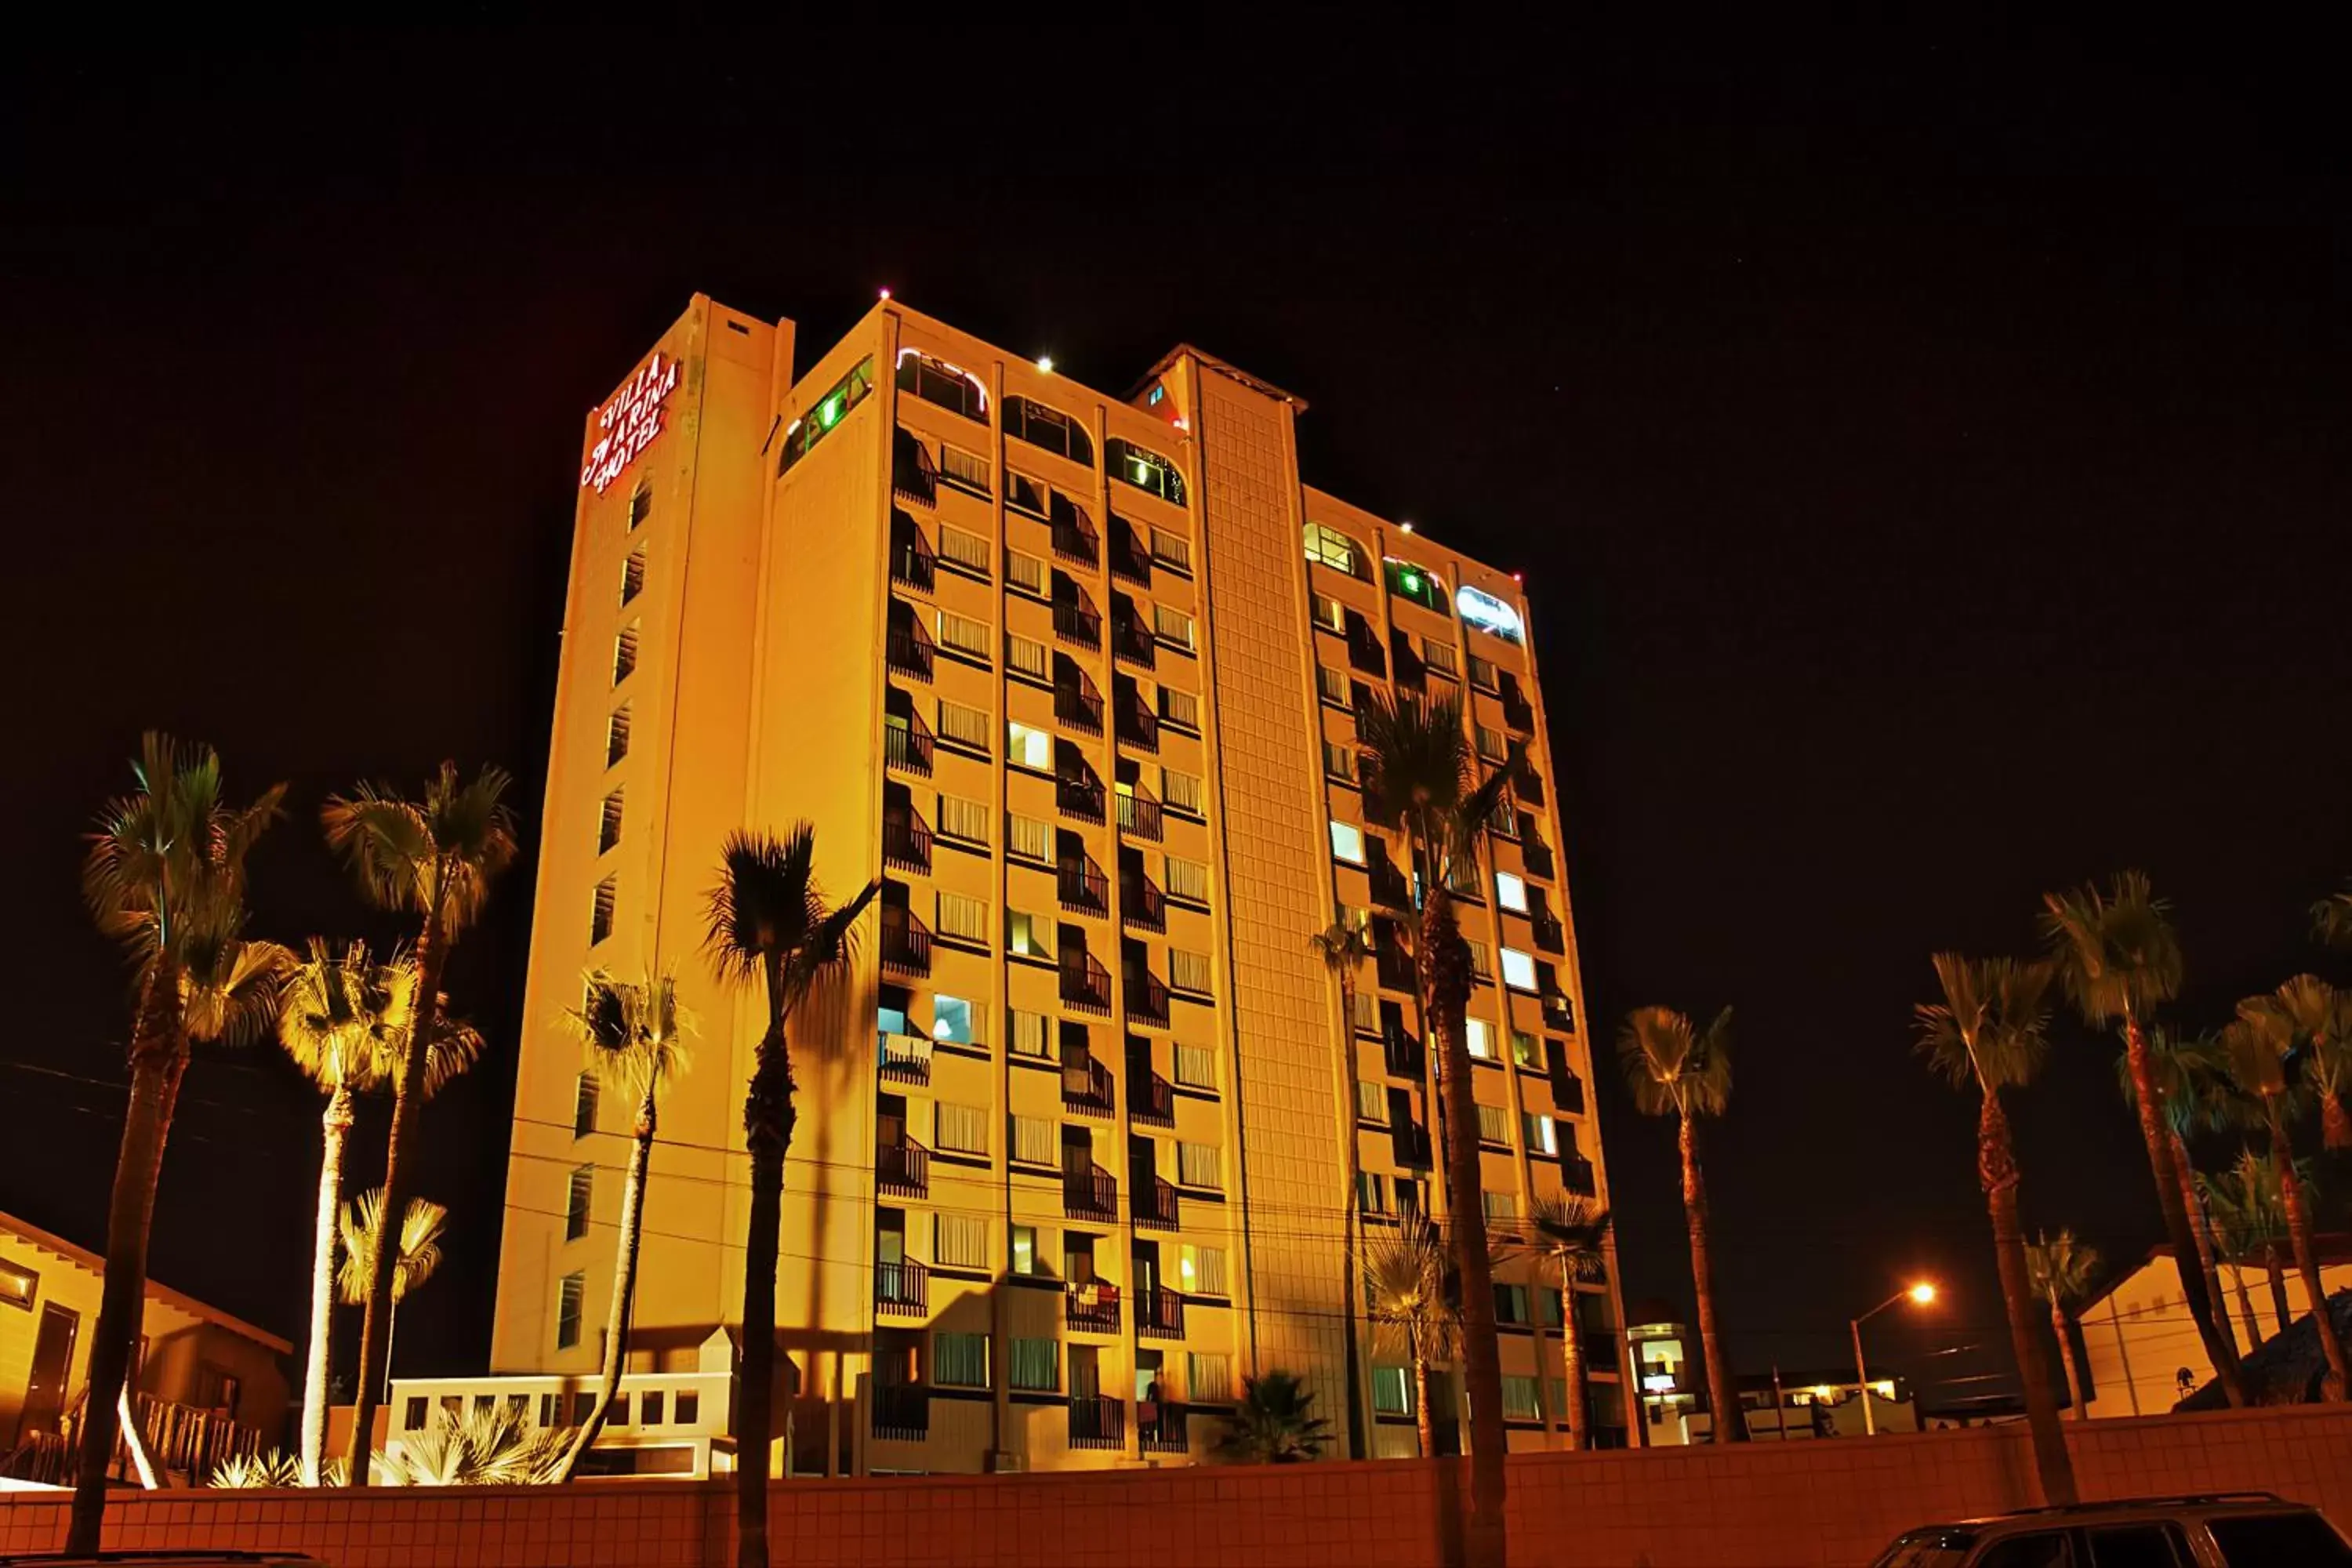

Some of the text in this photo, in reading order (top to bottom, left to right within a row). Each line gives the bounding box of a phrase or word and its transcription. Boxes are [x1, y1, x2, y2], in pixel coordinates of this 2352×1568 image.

[581, 364, 676, 486] MARINA
[600, 354, 660, 429] VILLA
[593, 408, 660, 493] HOTEL
